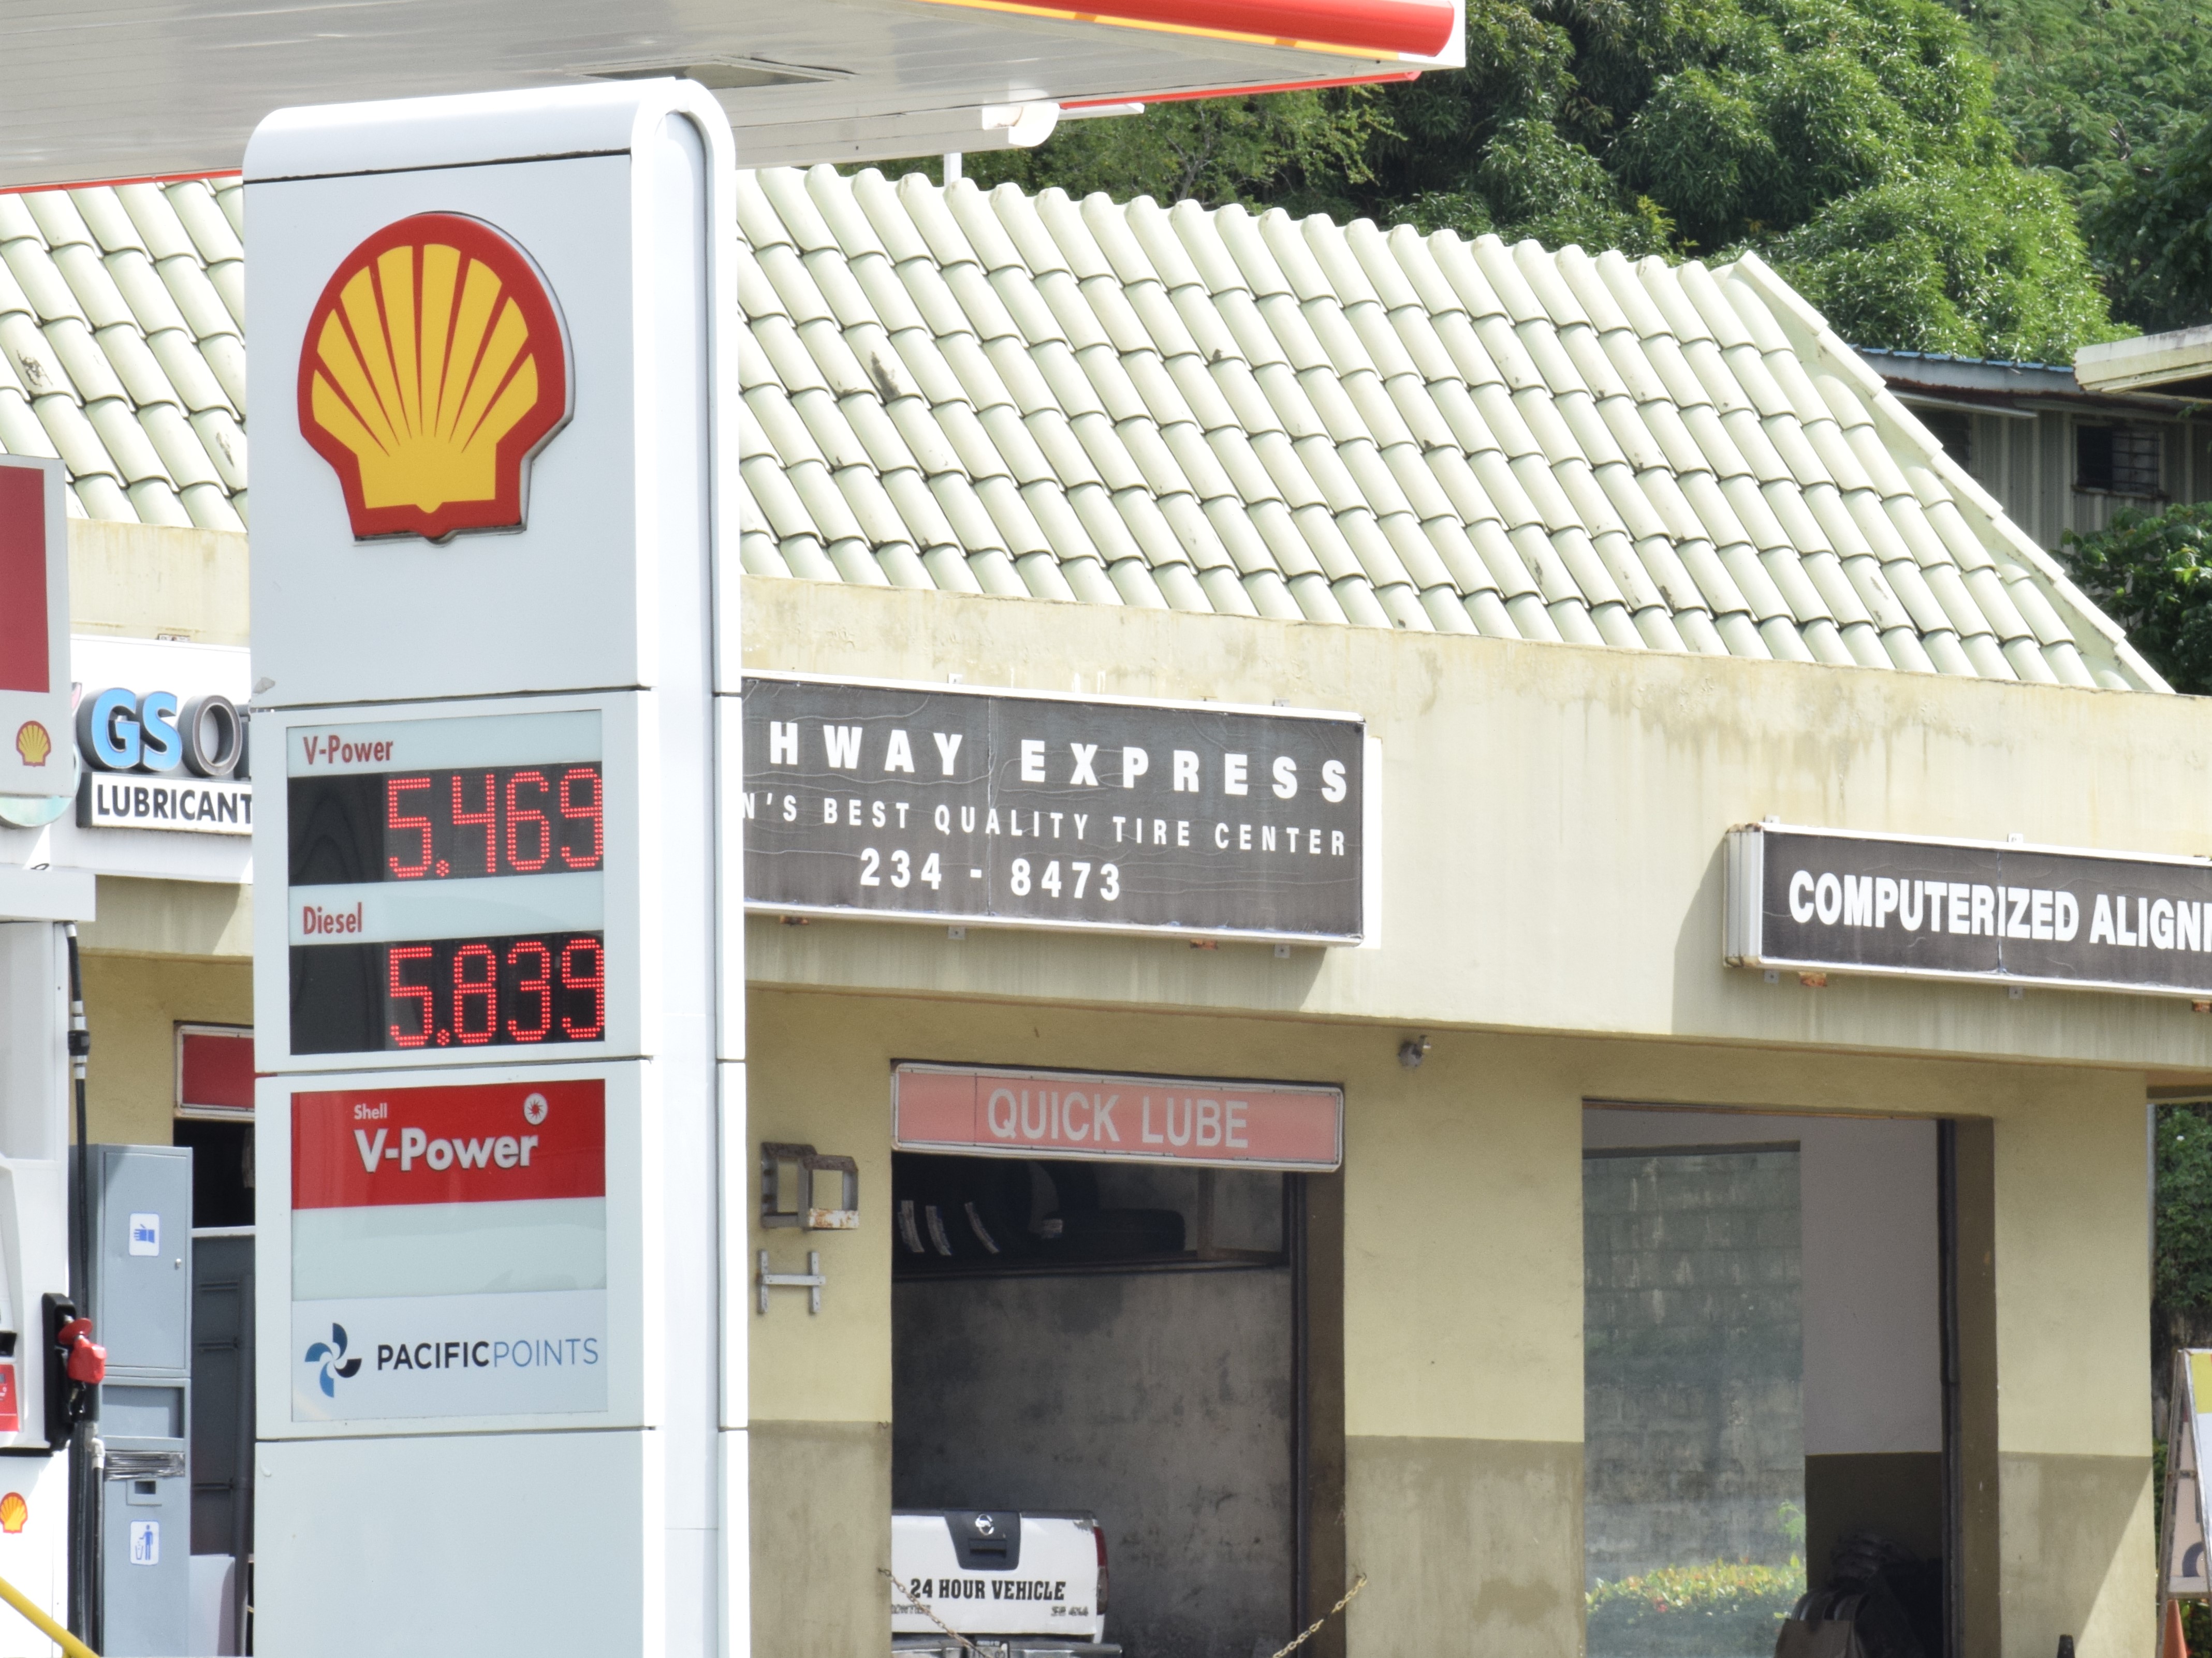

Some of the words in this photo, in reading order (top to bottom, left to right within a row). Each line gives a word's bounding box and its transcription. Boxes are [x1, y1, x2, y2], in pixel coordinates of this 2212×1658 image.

[303, 734, 393, 765] V-Power
[770, 721, 963, 776] HWAY
[1021, 739, 1347, 802] EXPRESS
[388, 768, 604, 878] 5.469
[824, 798, 909, 829] BEST
[934, 804, 1088, 840] QUALITY
[1112, 816, 1190, 846] TIRE
[1215, 823, 1344, 856] CENTER
[860, 847, 942, 890] 234
[1010, 858, 1120, 901] 8473
[303, 902, 362, 934] Diesel
[1789, 870, 2079, 942] COMPUTERIZED
[389, 938, 605, 1046] 5.839
[354, 1103, 388, 1120] Shell
[987, 1088, 1120, 1142] QUICK
[1141, 1096, 1248, 1148] LUBE
[353, 1127, 538, 1173] V-Power
[910, 1578, 933, 1598] 24
[939, 1579, 986, 1600] HOUR
[991, 1580, 1066, 1601] VEHICLE
